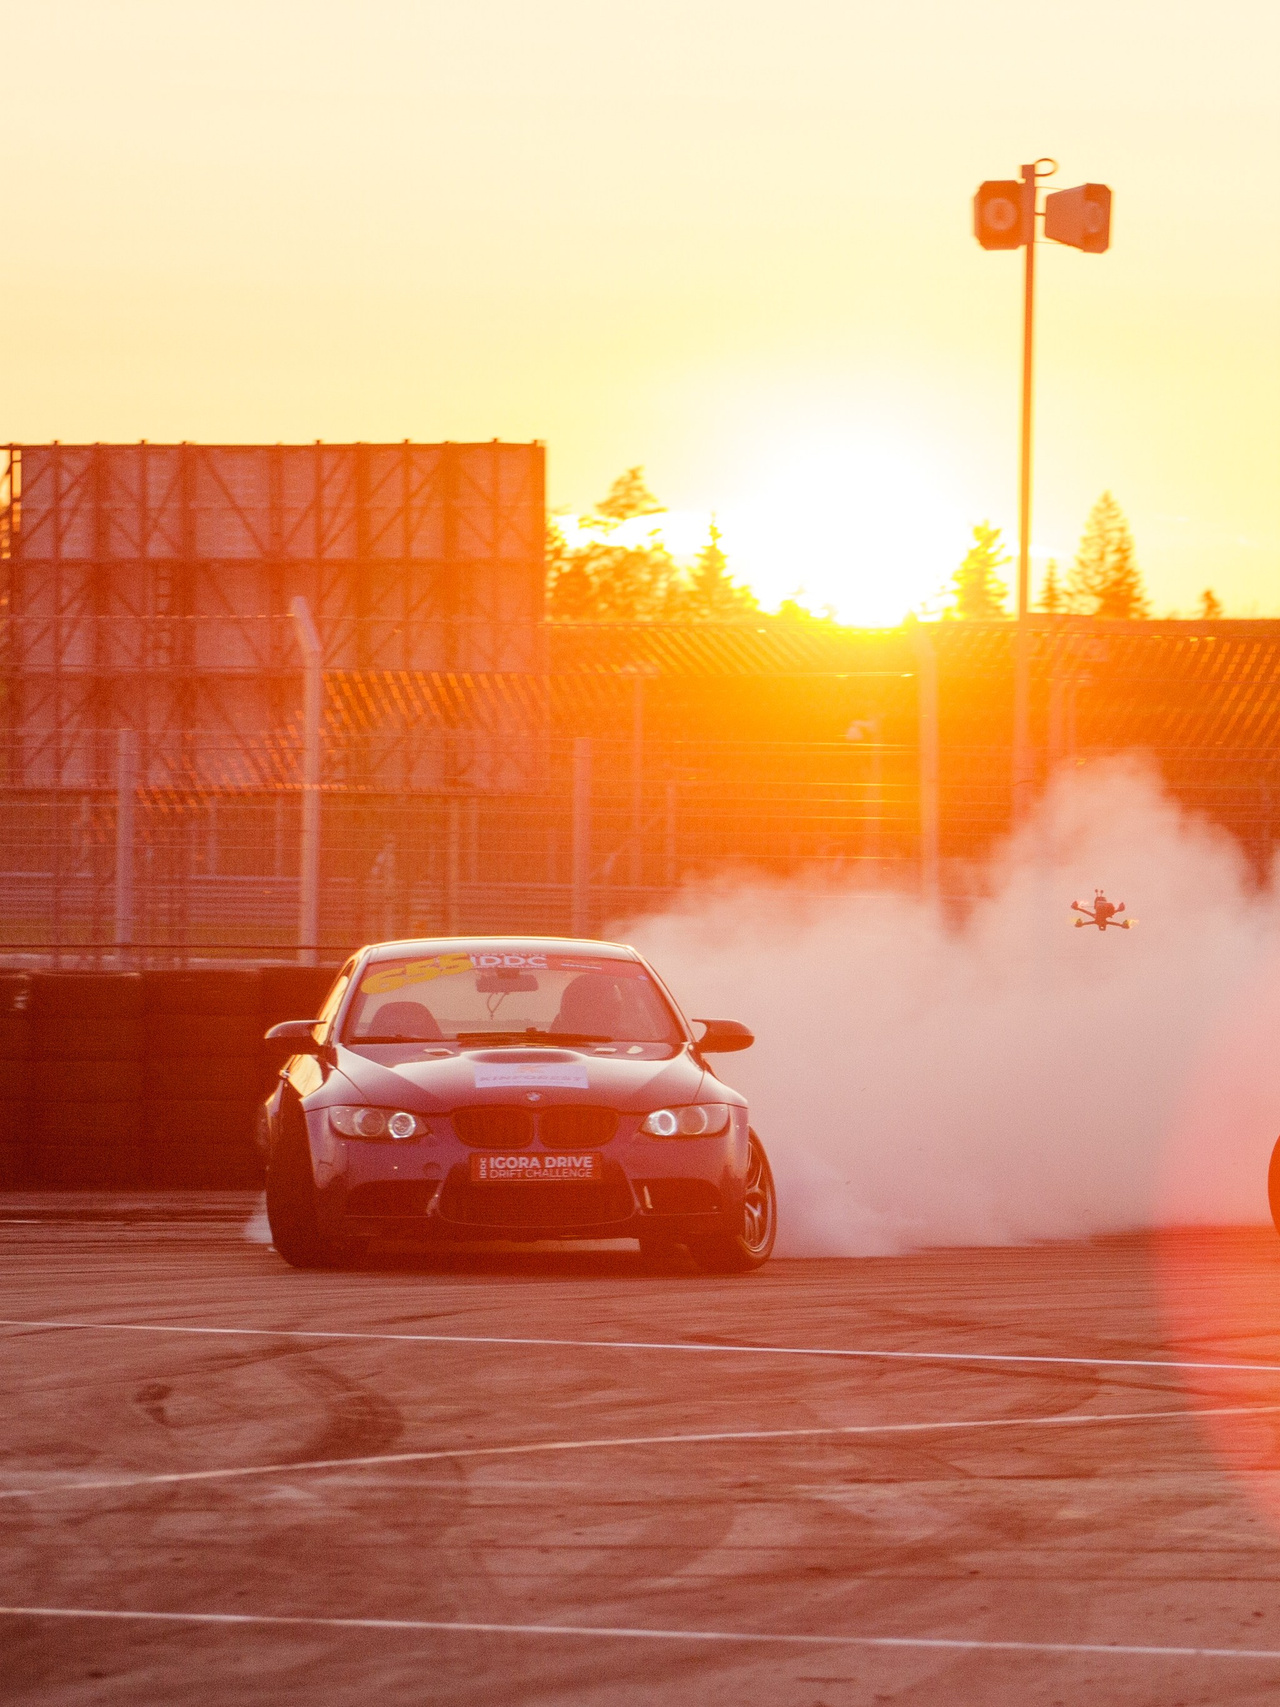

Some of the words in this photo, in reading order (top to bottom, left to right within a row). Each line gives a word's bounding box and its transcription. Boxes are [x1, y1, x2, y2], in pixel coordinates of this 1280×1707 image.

[470, 955, 548, 967] IDDC
[360, 952, 473, 995] 655
[479, 1157, 487, 1179] IDDC
[489, 1156, 541, 1169] IGORA
[544, 1156, 593, 1168] DRIVE
[489, 1169, 523, 1178] DRIFT
[525, 1168, 593, 1178] CHALLENGE
